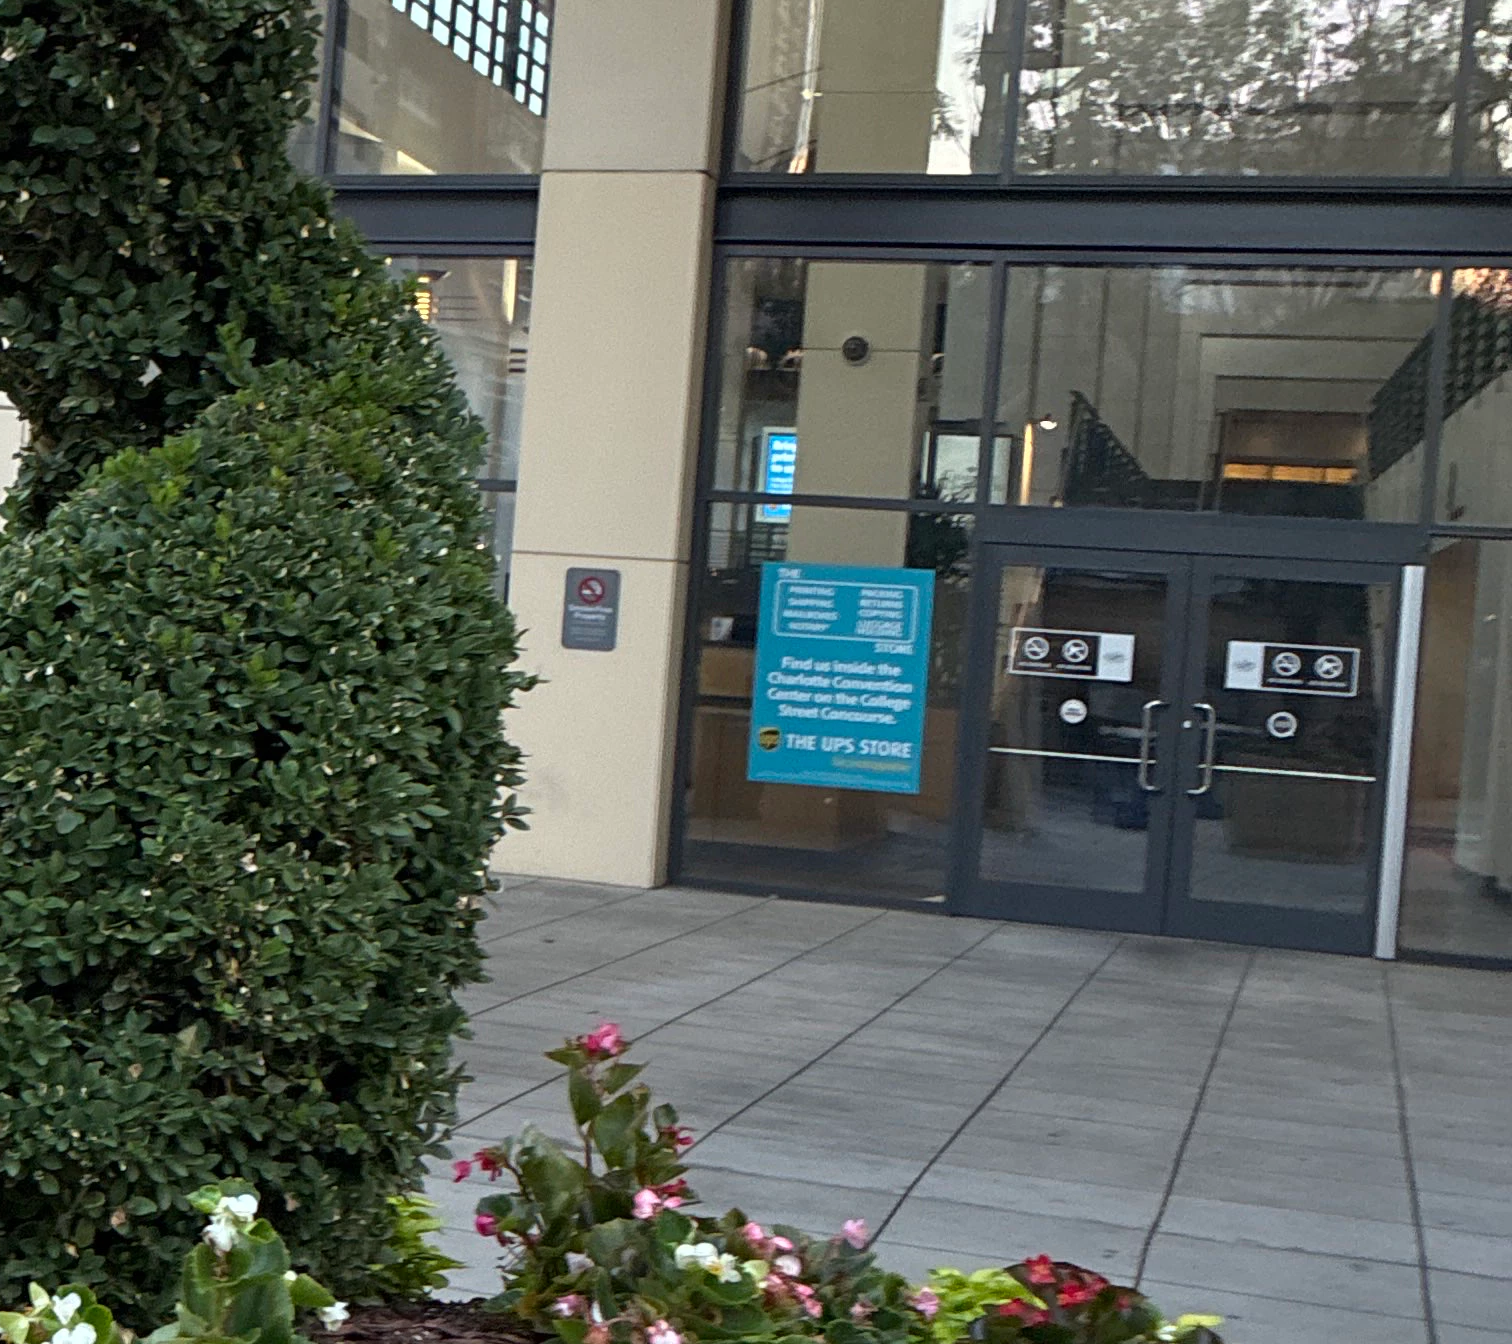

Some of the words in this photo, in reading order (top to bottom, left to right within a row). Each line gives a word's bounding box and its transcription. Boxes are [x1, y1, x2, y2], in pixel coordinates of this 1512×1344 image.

[781, 656, 813, 671] Find
[814, 660, 831, 672] us
[832, 659, 876, 675] inside
[877, 663, 903, 677] the
[767, 671, 831, 688] Charlotte
[832, 675, 913, 693] Convention
[767, 687, 813, 702] Center
[814, 692, 833, 704] on
[835, 692, 859, 705] the
[860, 693, 912, 712] College
[777, 703, 819, 719] Street
[820, 707, 897, 725] Concourse.
[786, 733, 817, 751] THE
[821, 736, 855, 754] UPS
[859, 739, 913, 759] STORE
